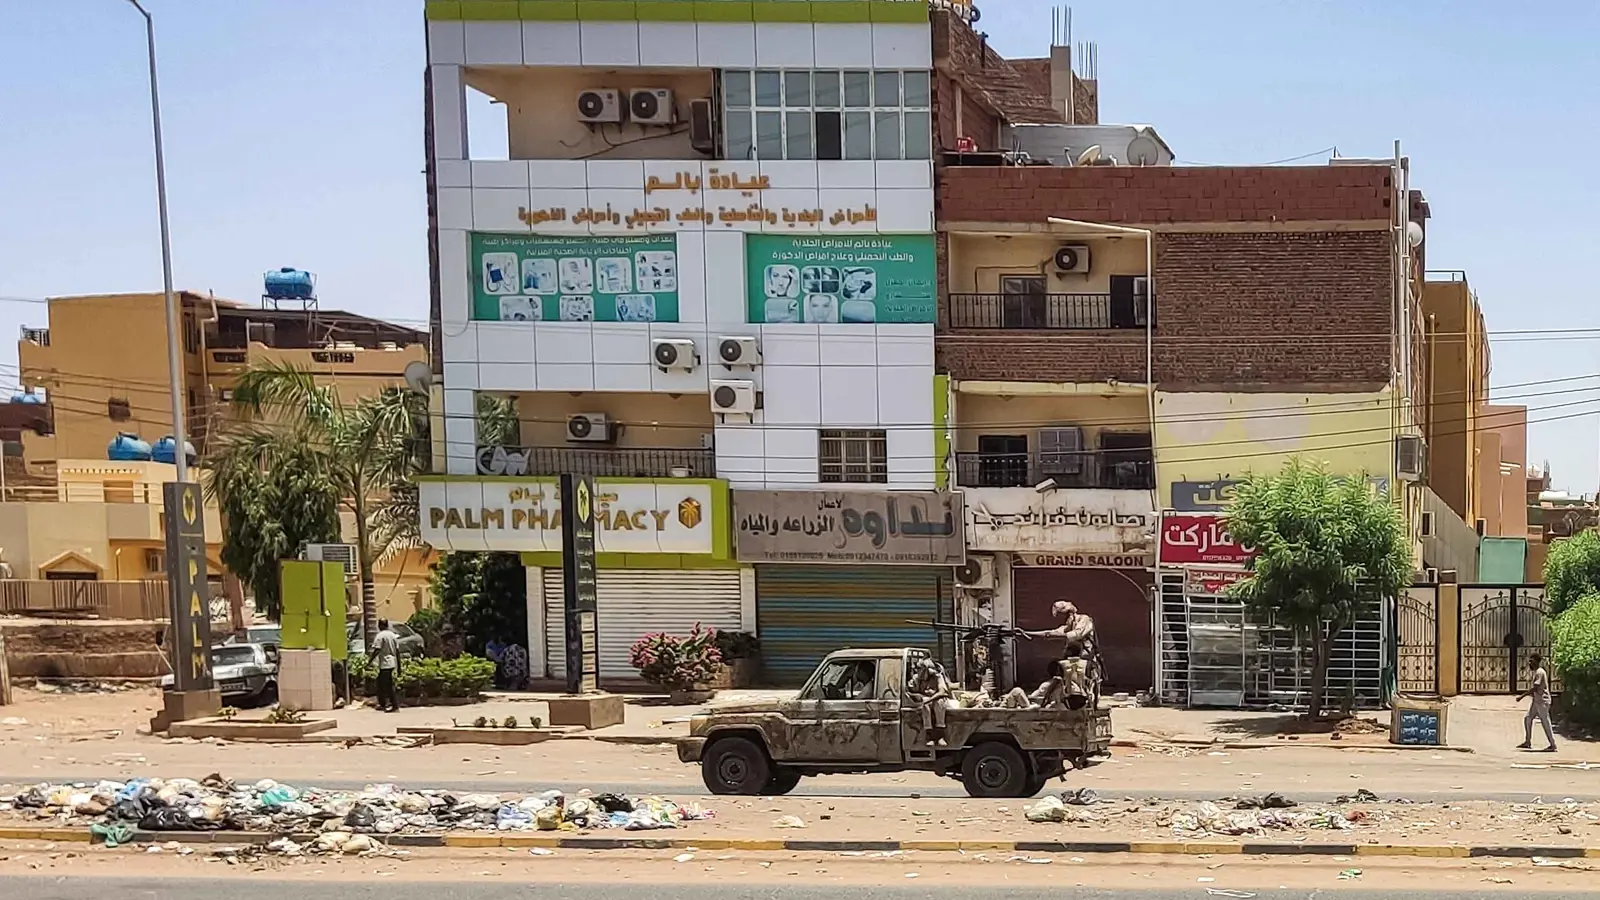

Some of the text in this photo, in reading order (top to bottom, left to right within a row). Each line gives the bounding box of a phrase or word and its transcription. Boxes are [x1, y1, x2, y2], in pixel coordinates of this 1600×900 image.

[646, 168, 770, 197] عيادة بالم
[430, 507, 670, 531] PALM PHAMACY
[1036, 554, 1144, 567] GRAND SALOON
[188, 558, 208, 681] PALM
